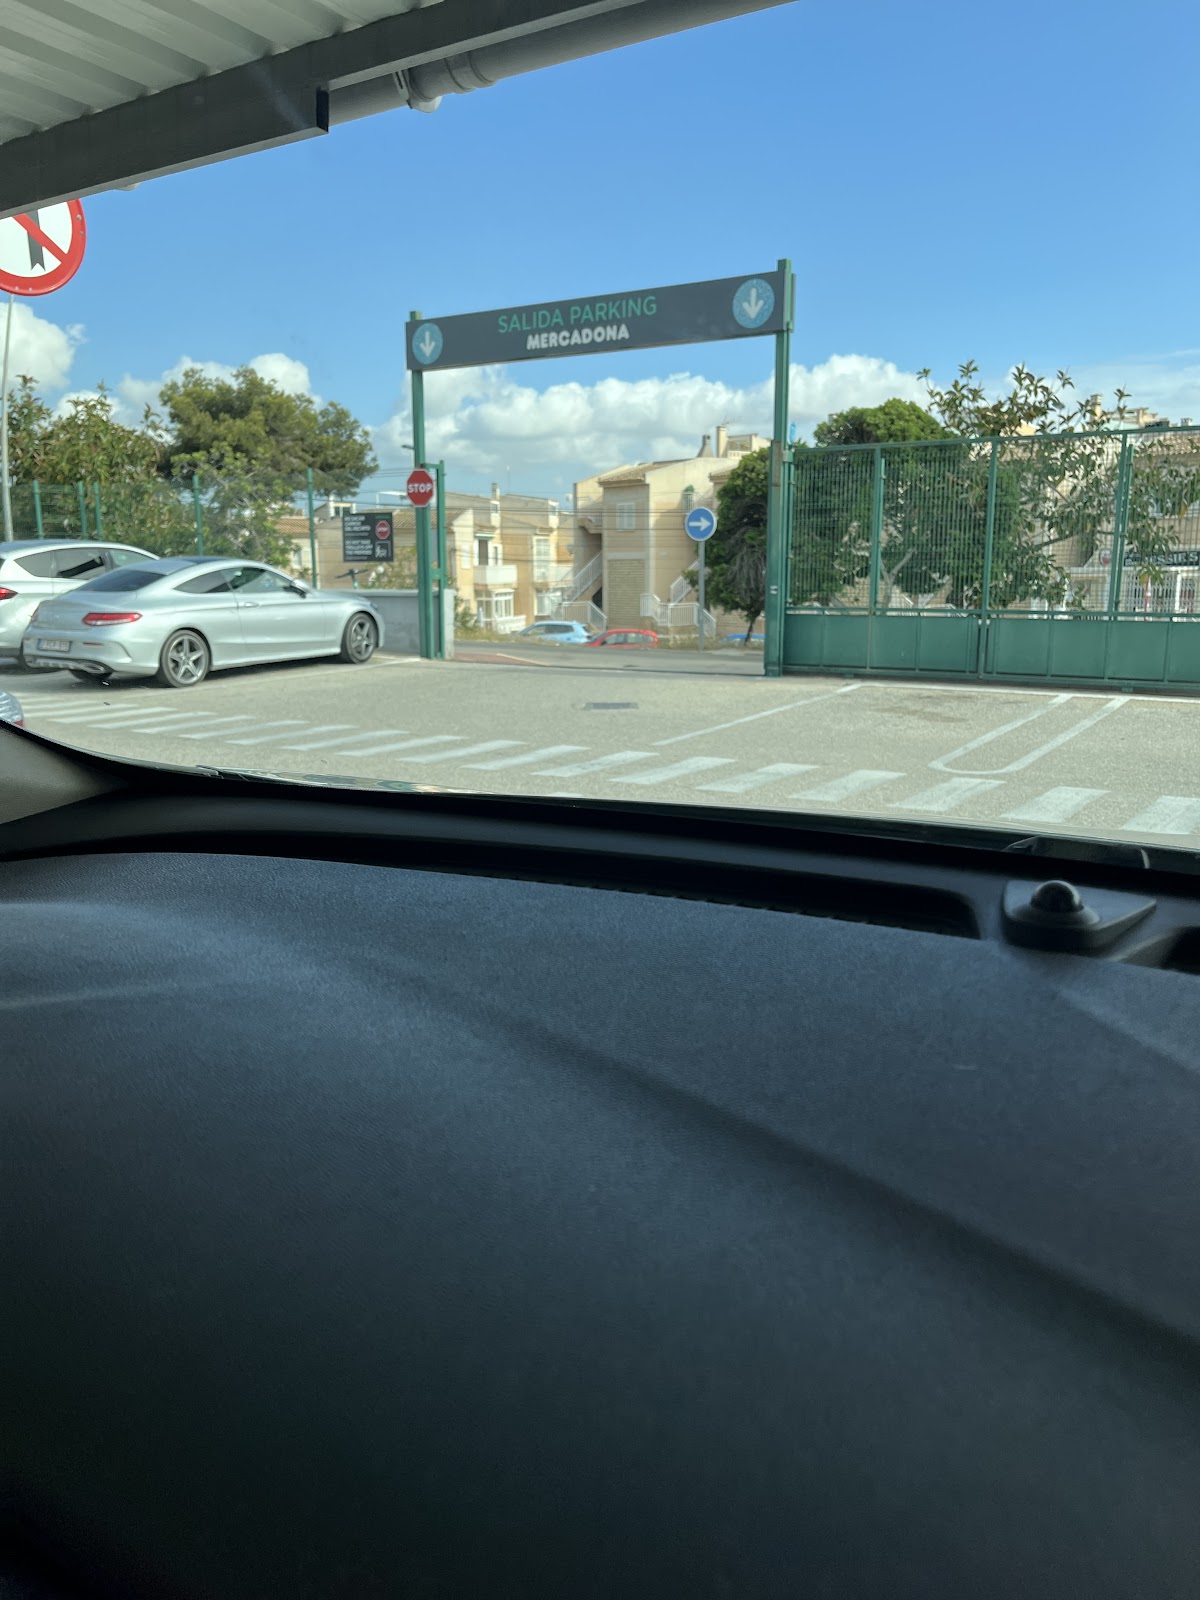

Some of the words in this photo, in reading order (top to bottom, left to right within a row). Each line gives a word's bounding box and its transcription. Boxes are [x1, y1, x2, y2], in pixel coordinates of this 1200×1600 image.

[498, 308, 564, 334] SALIDA
[570, 296, 657, 325] PARKING
[526, 323, 630, 350] MERCADONA
[408, 483, 432, 493] STOP
